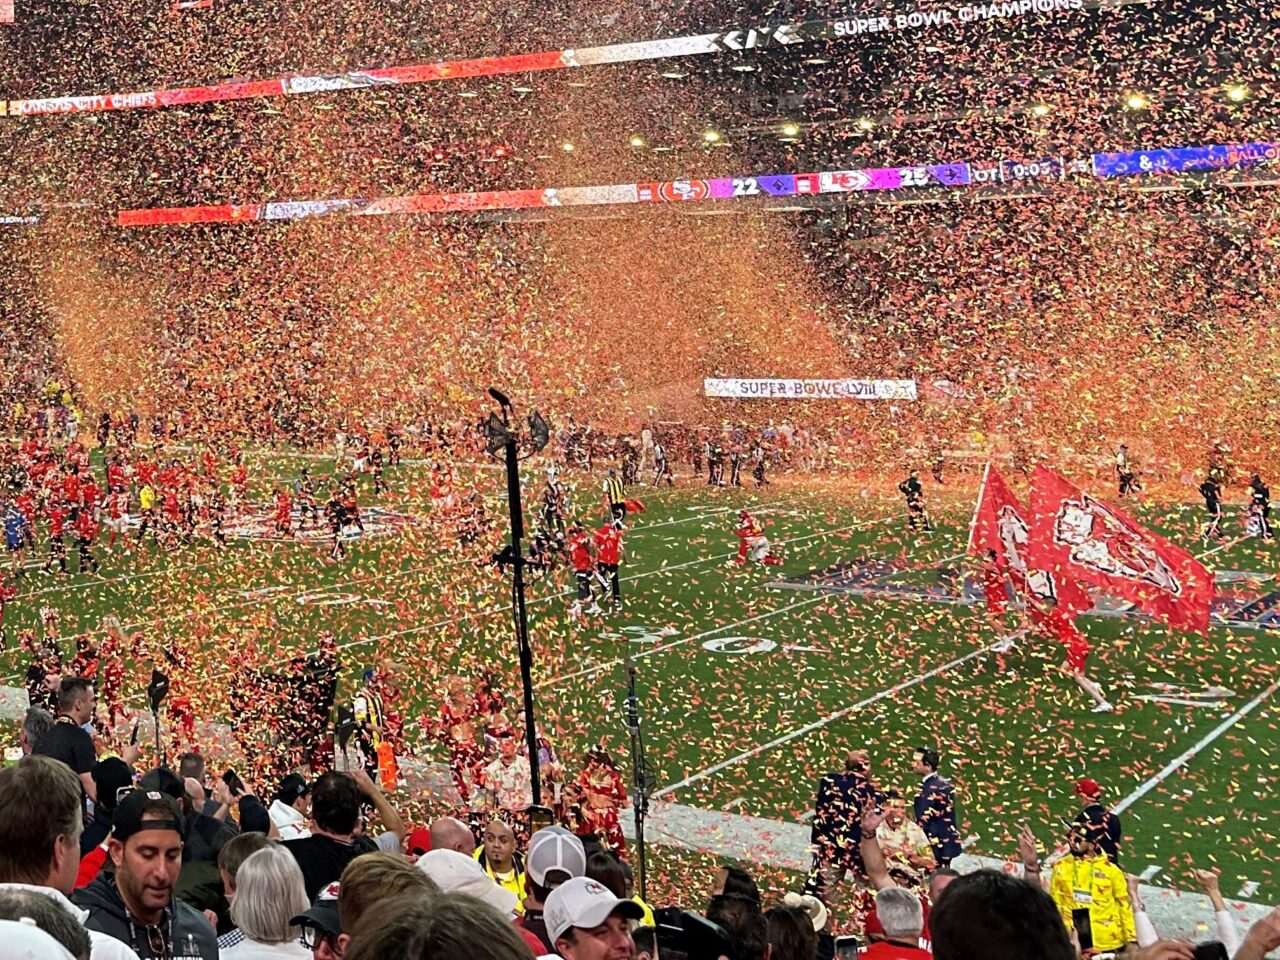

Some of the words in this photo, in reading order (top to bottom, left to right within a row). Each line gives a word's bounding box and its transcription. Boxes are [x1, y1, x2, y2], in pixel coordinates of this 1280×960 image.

[833, 16, 889, 37] SUPER
[896, 11, 953, 30] BOWL
[20, 98, 72, 113] KANSAS
[76, 95, 107, 110] CITY
[111, 93, 157, 107] CHIEFS
[899, 166, 928, 187] 25
[733, 178, 760, 196] 22
[740, 381, 786, 395] SUPER
[794, 382, 844, 396] BOWL
